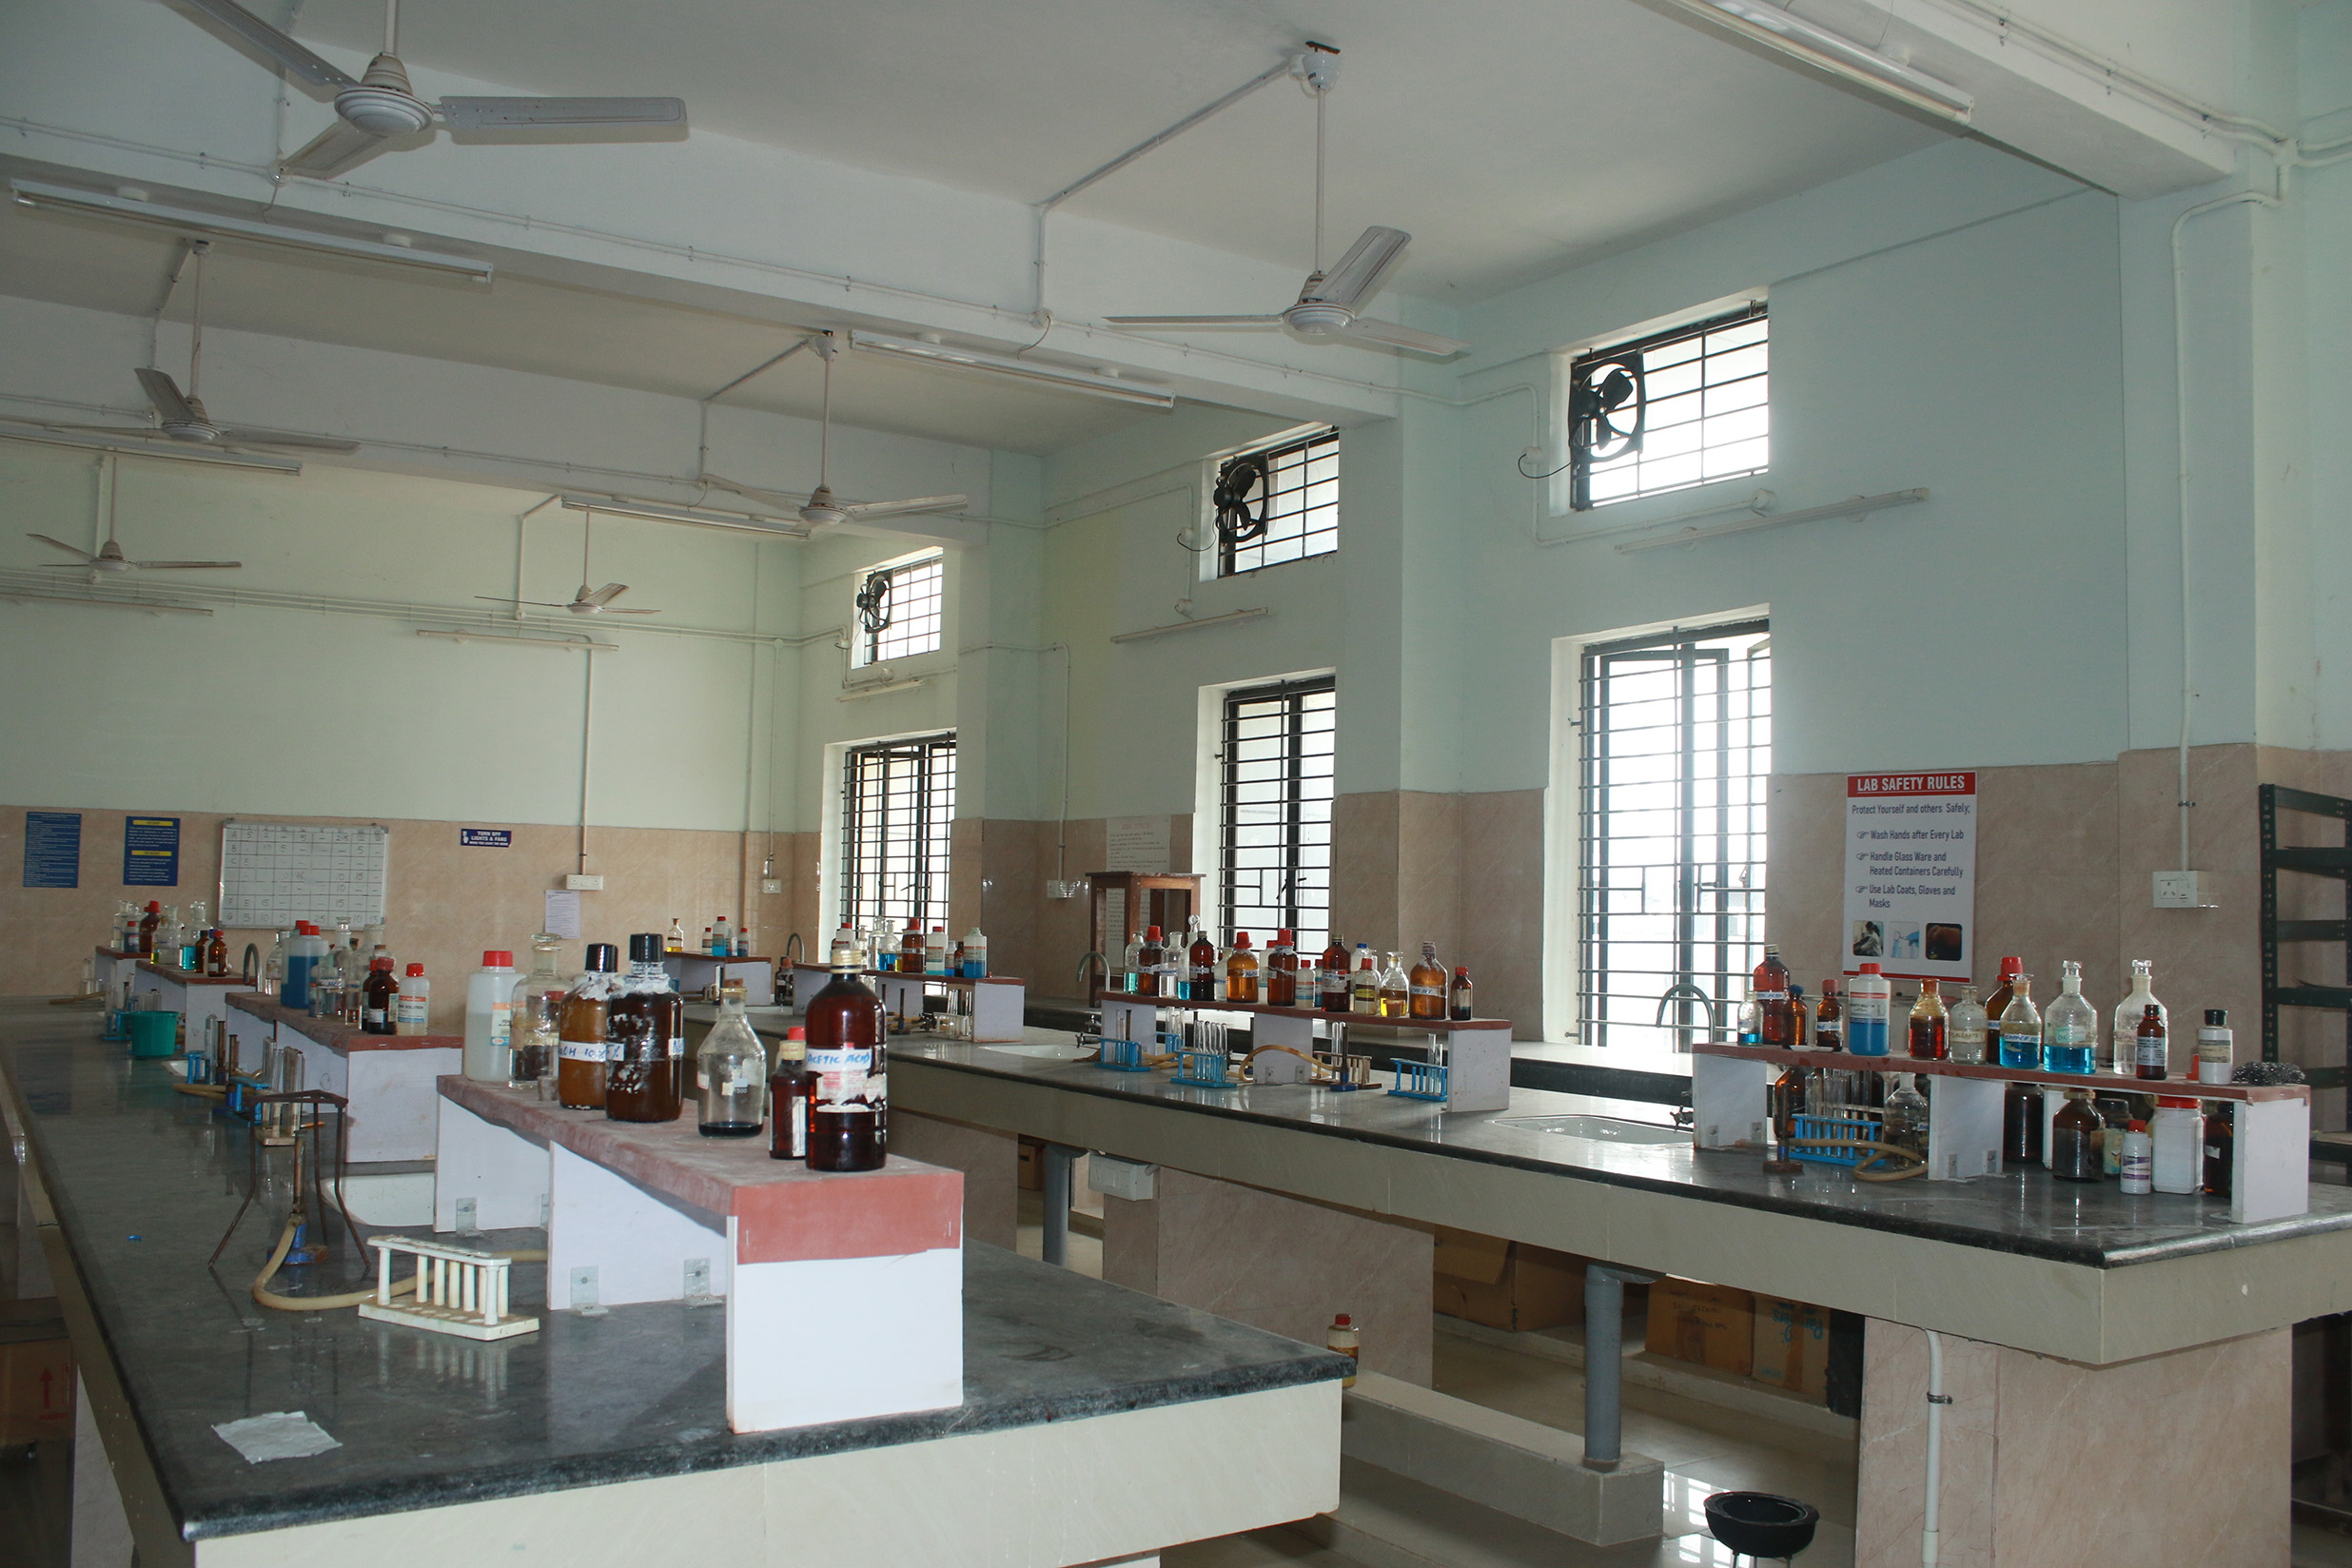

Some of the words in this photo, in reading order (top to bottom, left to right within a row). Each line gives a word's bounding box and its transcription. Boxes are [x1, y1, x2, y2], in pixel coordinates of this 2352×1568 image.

[1857, 778, 1878, 791] LAB
[1882, 776, 1924, 791] SAFETY
[1928, 775, 1965, 789] RULES
[1852, 805, 1876, 814] Protect
[1877, 804, 1904, 813] Yourself
[1906, 804, 1918, 813] and
[1920, 804, 1943, 813] others
[1871, 830, 1888, 839] Wash
[1890, 830, 1911, 839] Hands
[1911, 830, 1928, 839] after
[1931, 830, 1950, 841] Every
[1950, 830, 1964, 839] Lab
[358, 845, 364, 854] 5
[1870, 852, 1892, 861] Handle
[1894, 852, 1913, 861] Glass
[1914, 852, 1931, 861] Ware
[1933, 853, 1947, 861] and
[1870, 866, 1892, 875] Heated
[1893, 866, 1931, 875] Containers
[1931, 866, 1964, 878] Carefully
[1869, 885, 1881, 893] Use
[1883, 885, 1895, 894] Lab
[1896, 885, 1917, 895] Coats,
[1918, 885, 1941, 895] Gloves
[1942, 886, 1955, 895] and
[336, 899, 344, 908] 15
[1869, 898, 1891, 908] Masks
[244, 913, 251, 922] 5
[280, 913, 287, 923] 5
[354, 914, 363, 923] 10
[807, 1052, 841, 1065] ACETIC
[845, 1052, 871, 1065] ACID
